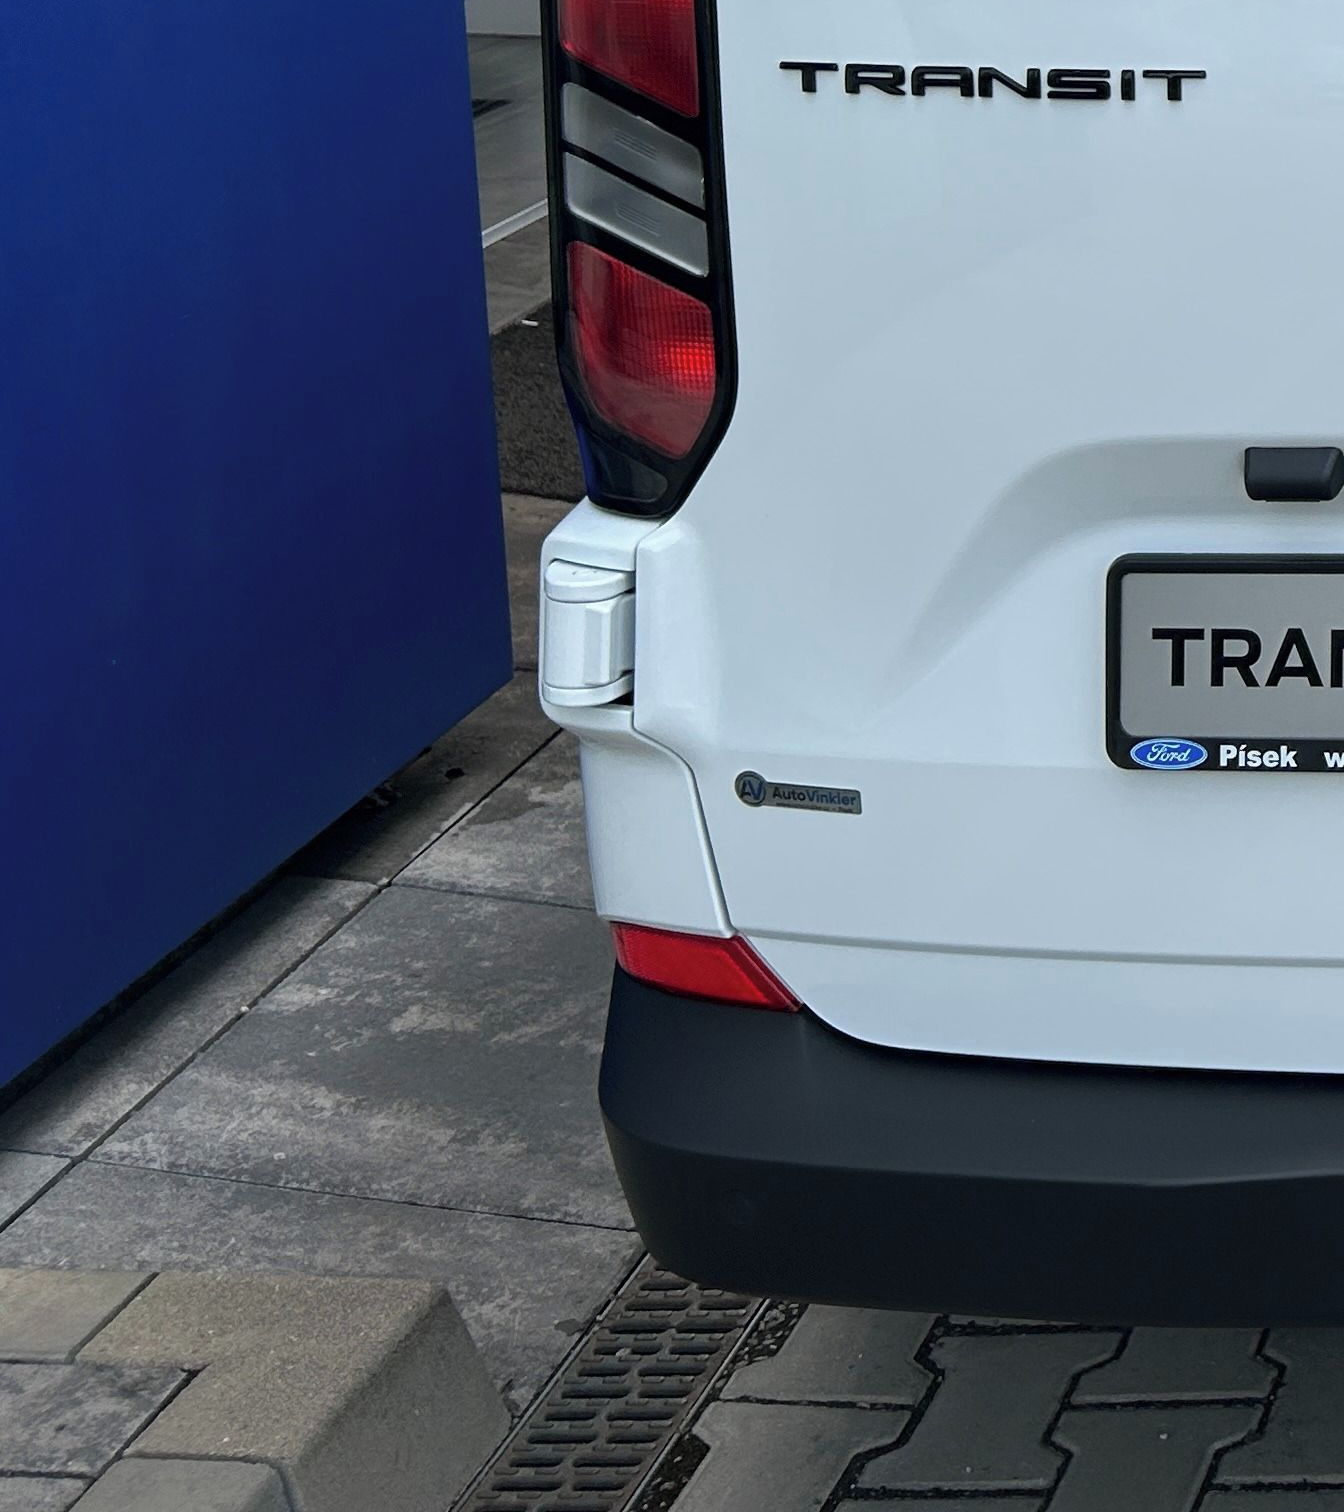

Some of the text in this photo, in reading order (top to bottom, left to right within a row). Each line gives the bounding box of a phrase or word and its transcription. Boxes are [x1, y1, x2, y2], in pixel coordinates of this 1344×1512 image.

[779, 61, 1207, 101] TRANSIT
[1146, 743, 1192, 763] Ford
[1219, 744, 1297, 768] Písek
